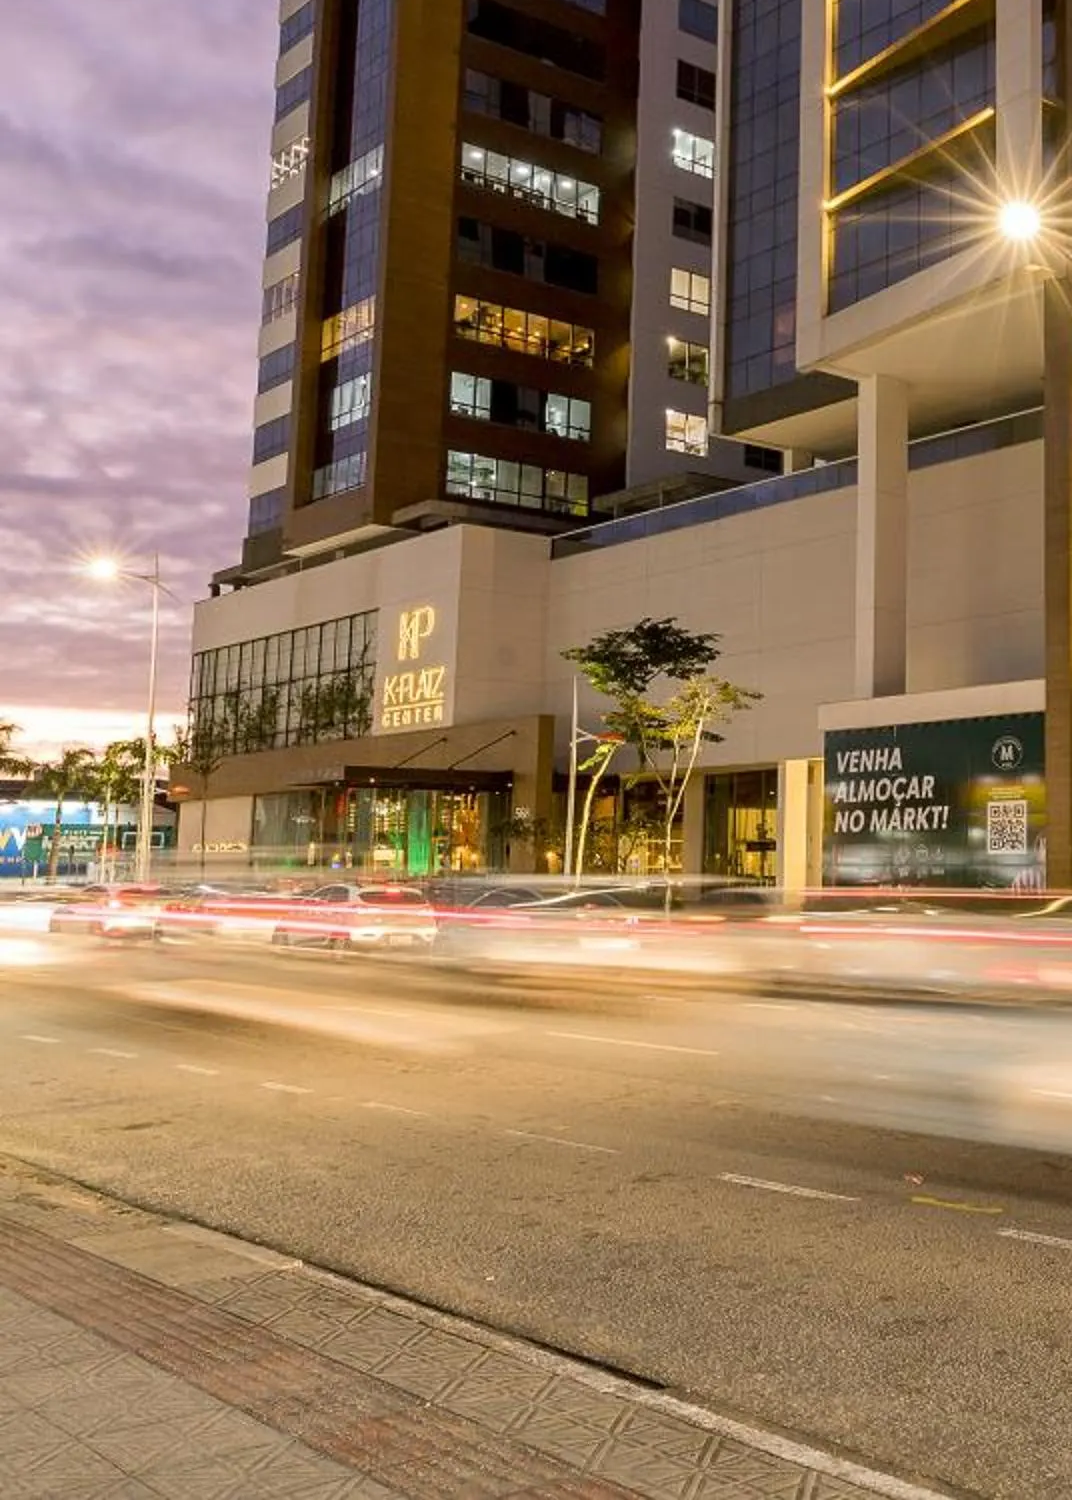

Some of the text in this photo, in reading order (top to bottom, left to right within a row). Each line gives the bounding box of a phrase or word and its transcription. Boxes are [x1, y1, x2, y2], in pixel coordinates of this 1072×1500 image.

[381, 705, 443, 727] CENTER
[836, 748, 903, 773] VENHA
[834, 775, 935, 806] ALMOÇAR
[834, 805, 949, 833] NO MARKT!
